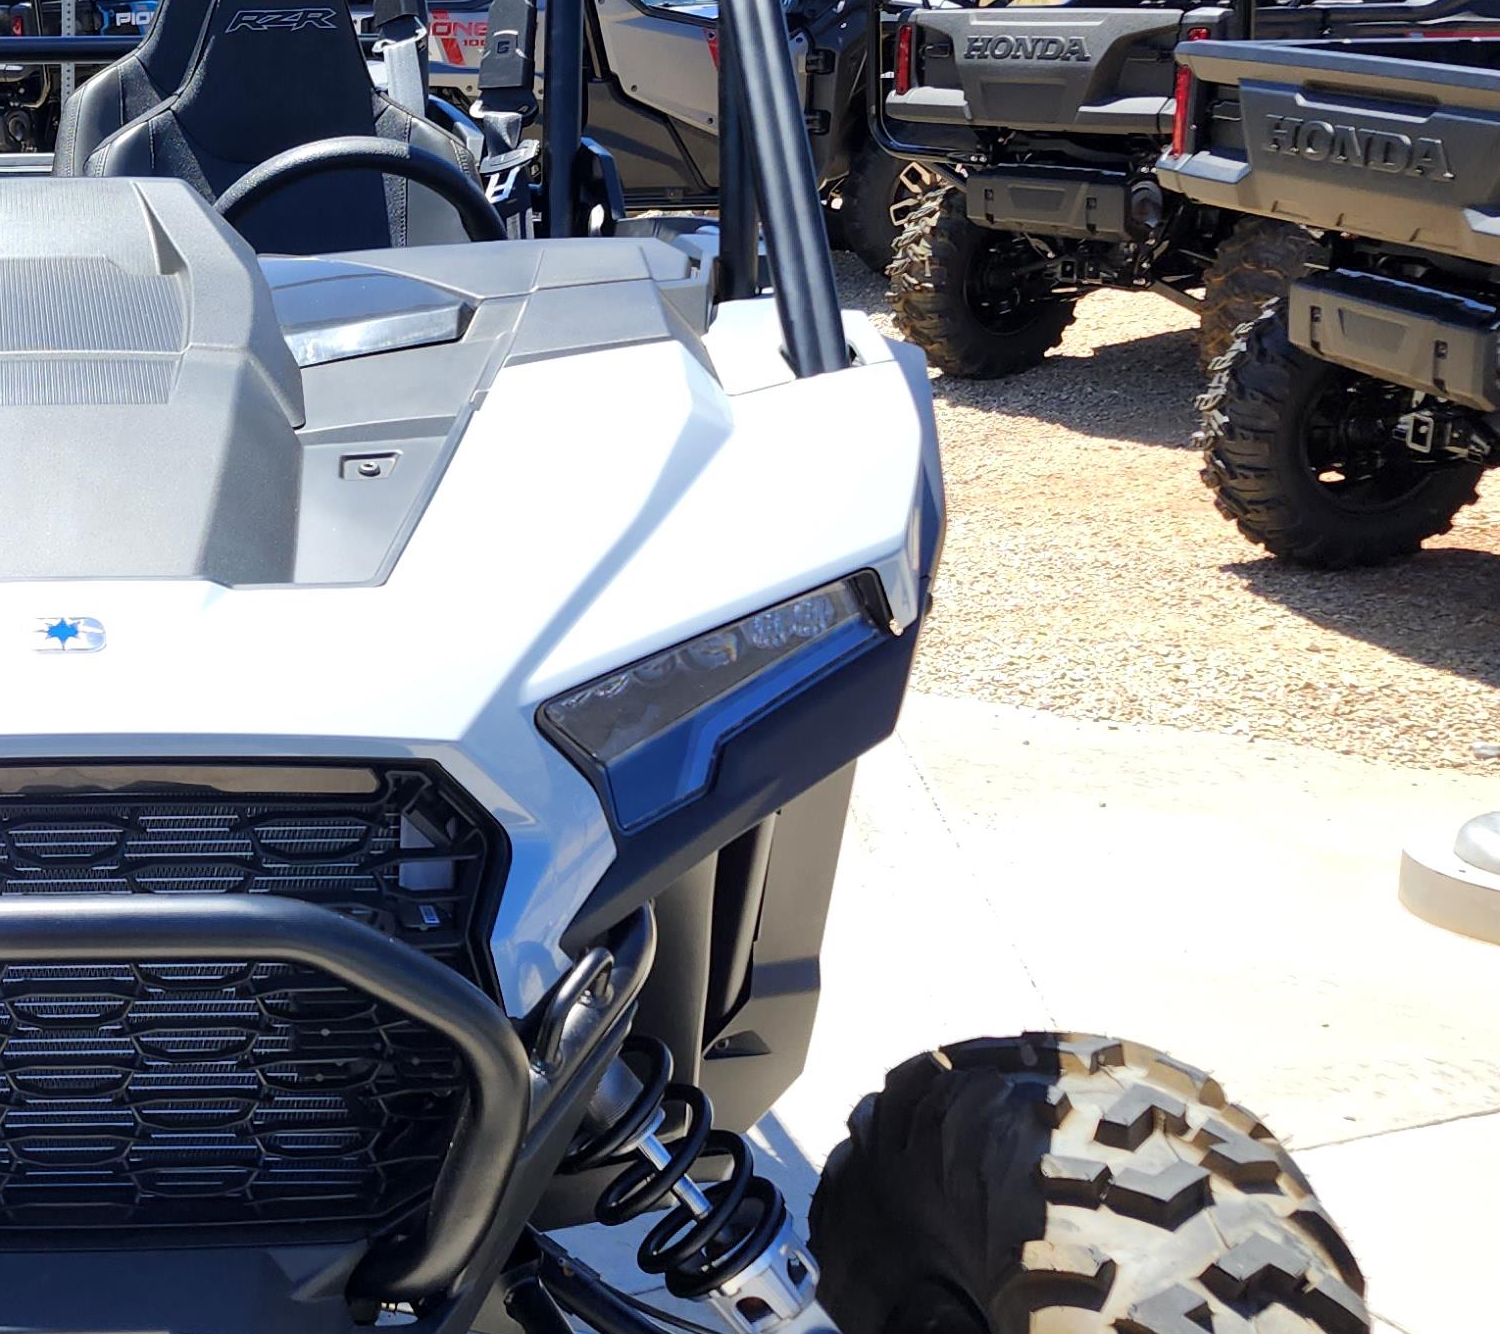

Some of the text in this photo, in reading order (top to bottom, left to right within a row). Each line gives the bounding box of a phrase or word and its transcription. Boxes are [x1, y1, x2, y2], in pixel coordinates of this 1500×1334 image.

[225, 8, 338, 33] RZR
[963, 35, 1091, 62] HONDA
[1261, 114, 1456, 182] HONDA
